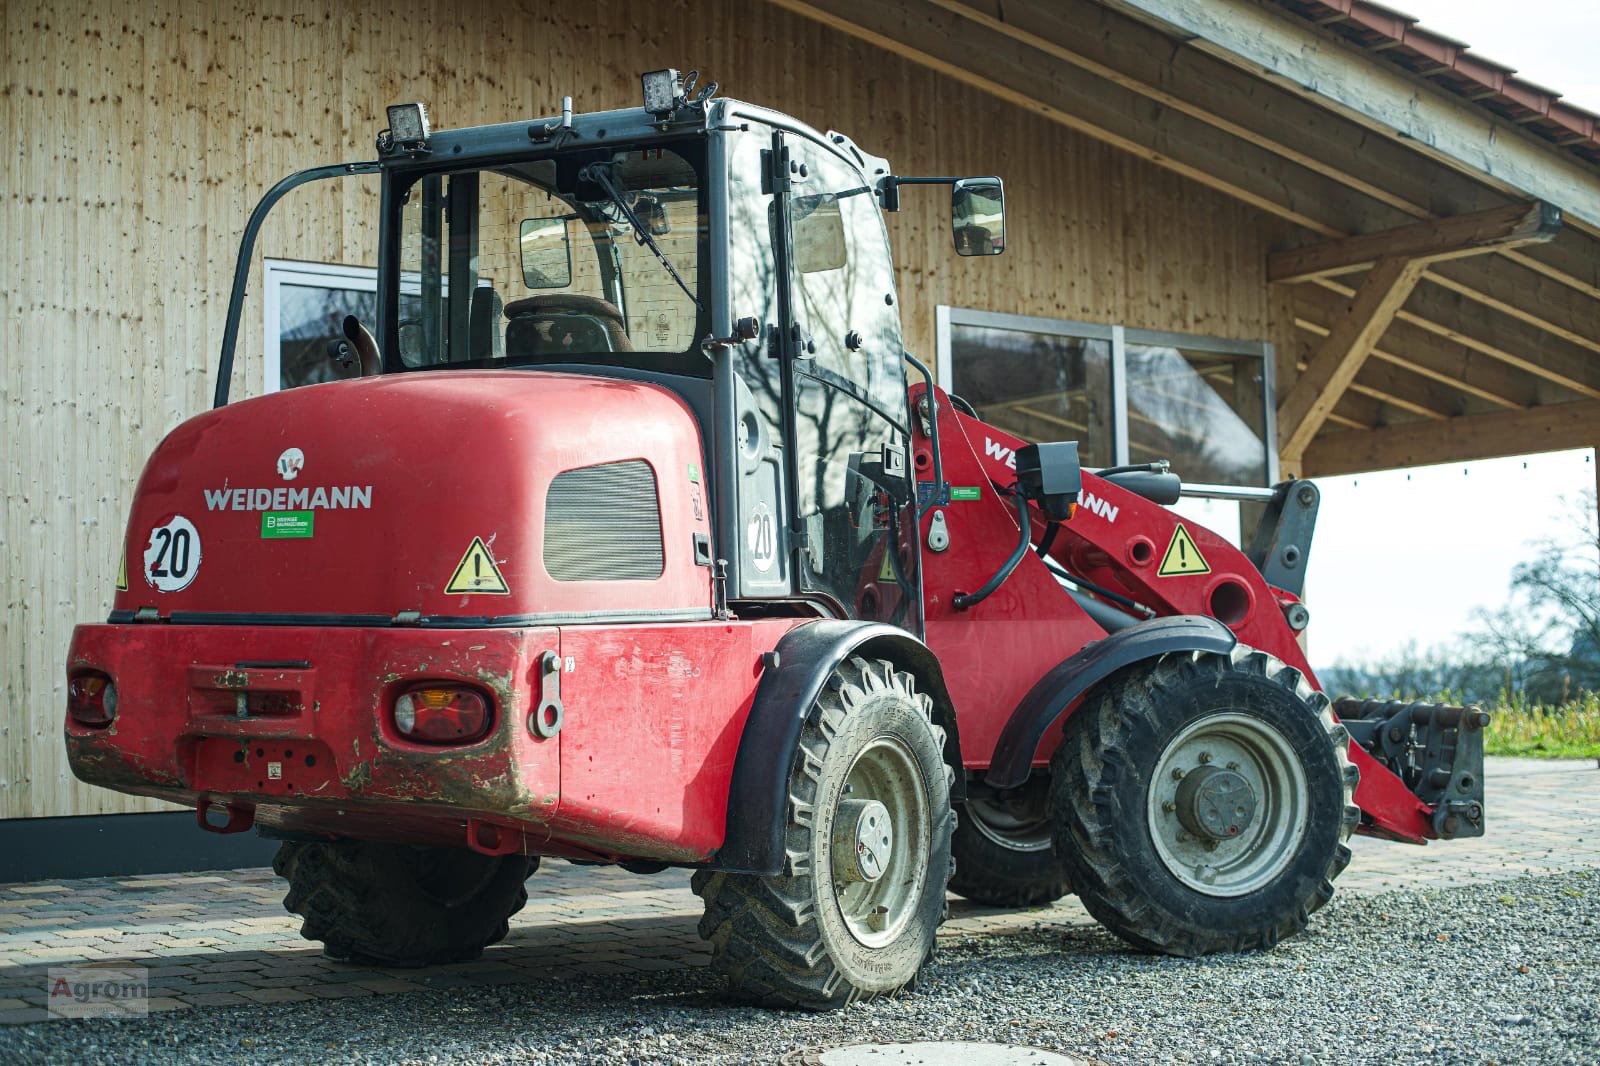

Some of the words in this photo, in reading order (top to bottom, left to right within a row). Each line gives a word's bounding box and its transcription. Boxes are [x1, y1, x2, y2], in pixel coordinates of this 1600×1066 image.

[204, 485, 373, 511] WEIDEMANN
[151, 527, 191, 579] 20
[753, 514, 771, 559] 20
